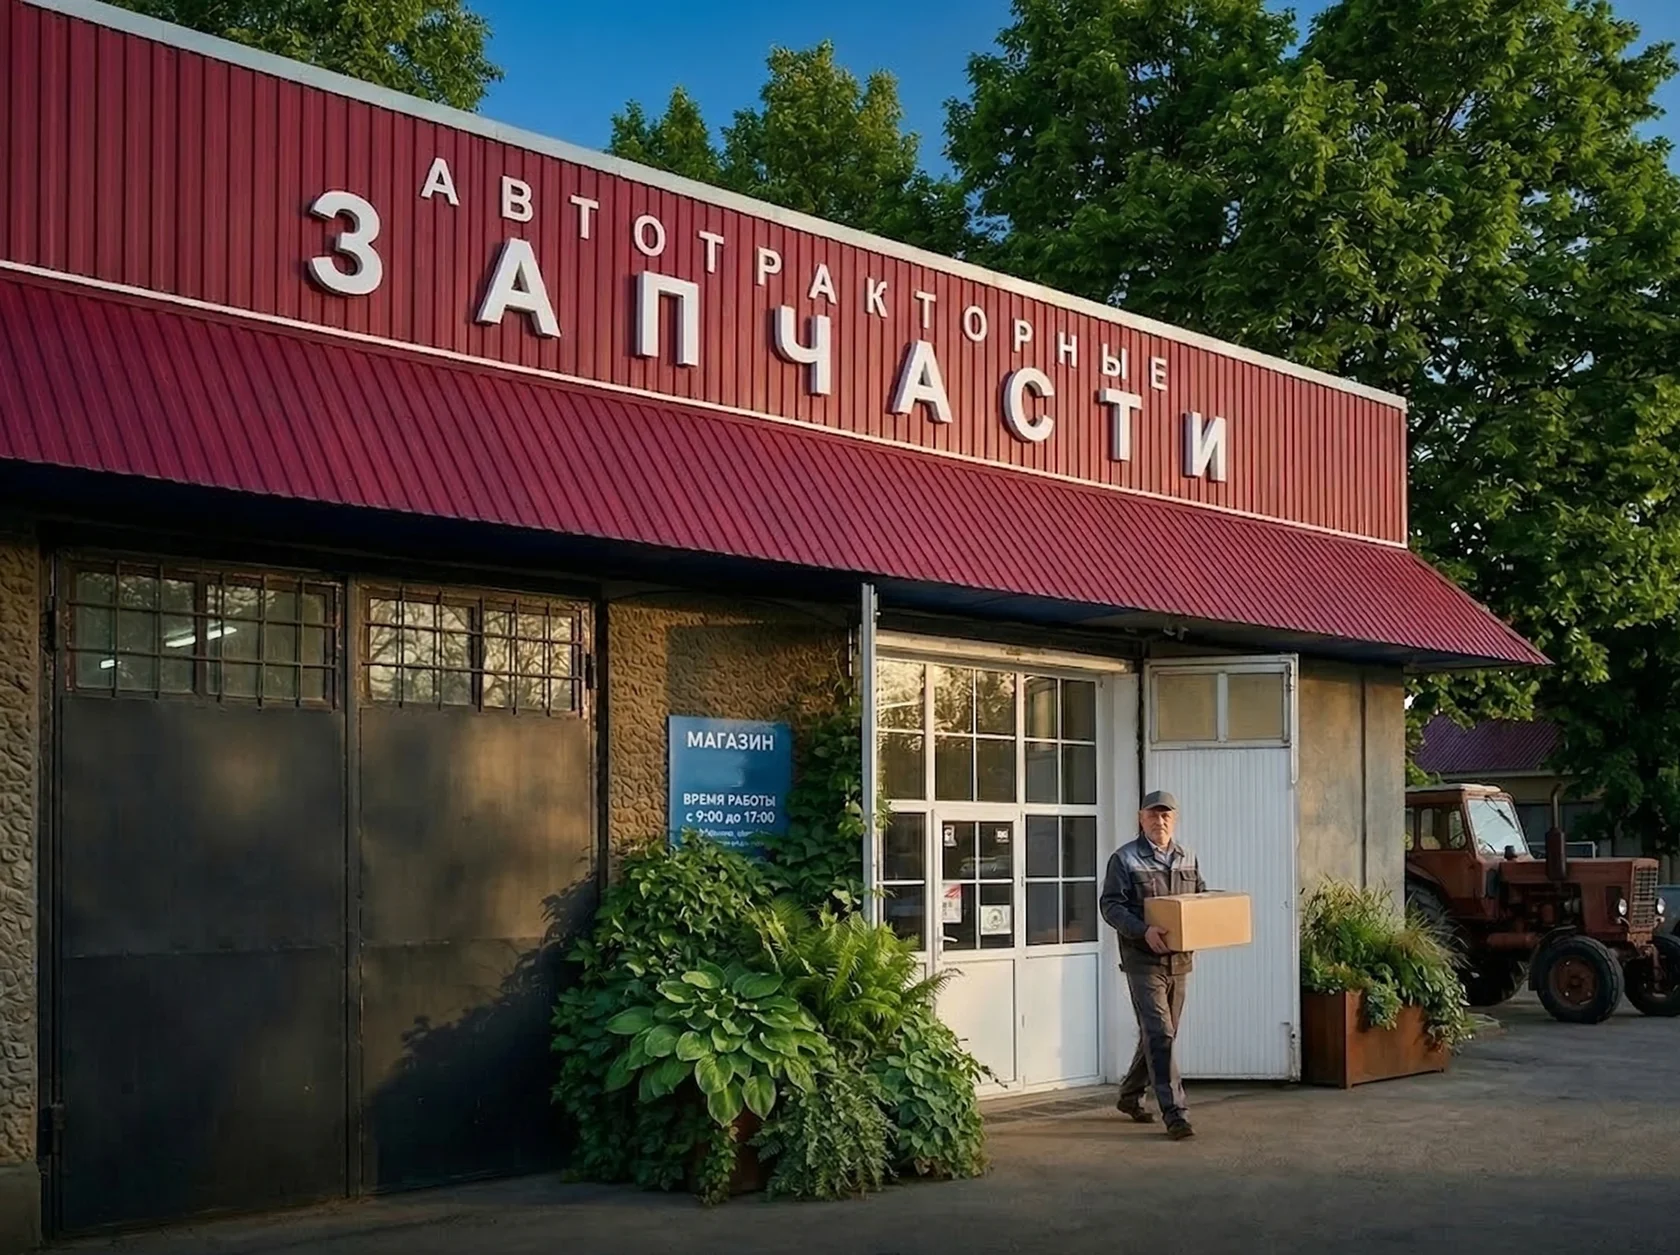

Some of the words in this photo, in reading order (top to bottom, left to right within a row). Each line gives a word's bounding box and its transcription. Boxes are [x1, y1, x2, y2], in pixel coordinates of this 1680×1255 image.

[421, 157, 1168, 391] АВТОТРАКТОРНЫЕ
[308, 190, 1227, 482] ЗАПЧАСТИ
[687, 731, 774, 751] МАГАЗИН
[683, 793, 725, 806] ВРЕМЯ
[728, 794, 776, 807] РАБОТЫ
[695, 810, 724, 823] 9:00
[725, 813, 741, 824] до
[744, 811, 775, 824] 17:00
